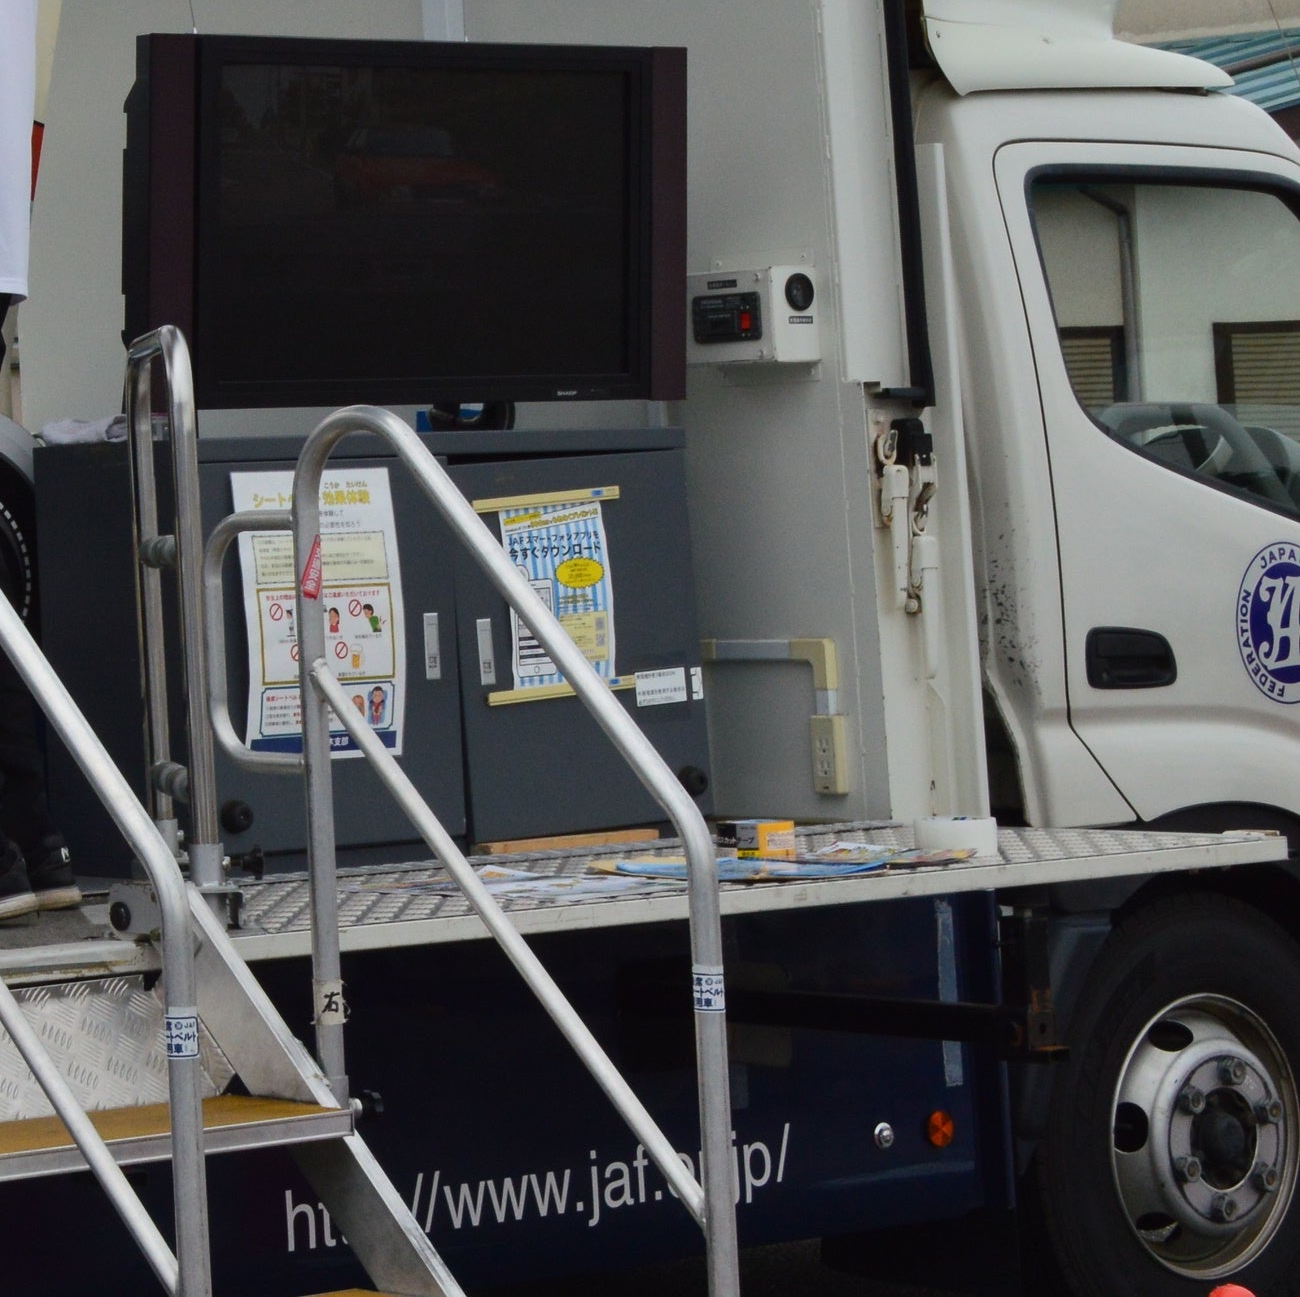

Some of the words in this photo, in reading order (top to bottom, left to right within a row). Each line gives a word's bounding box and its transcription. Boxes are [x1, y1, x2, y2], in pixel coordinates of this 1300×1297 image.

[508, 541, 601, 561] 今すぐダウンロード
[1259, 546, 1300, 570] JAPA
[1239, 588, 1287, 698] FEDERATION
[322, 991, 341, 1014] 右
